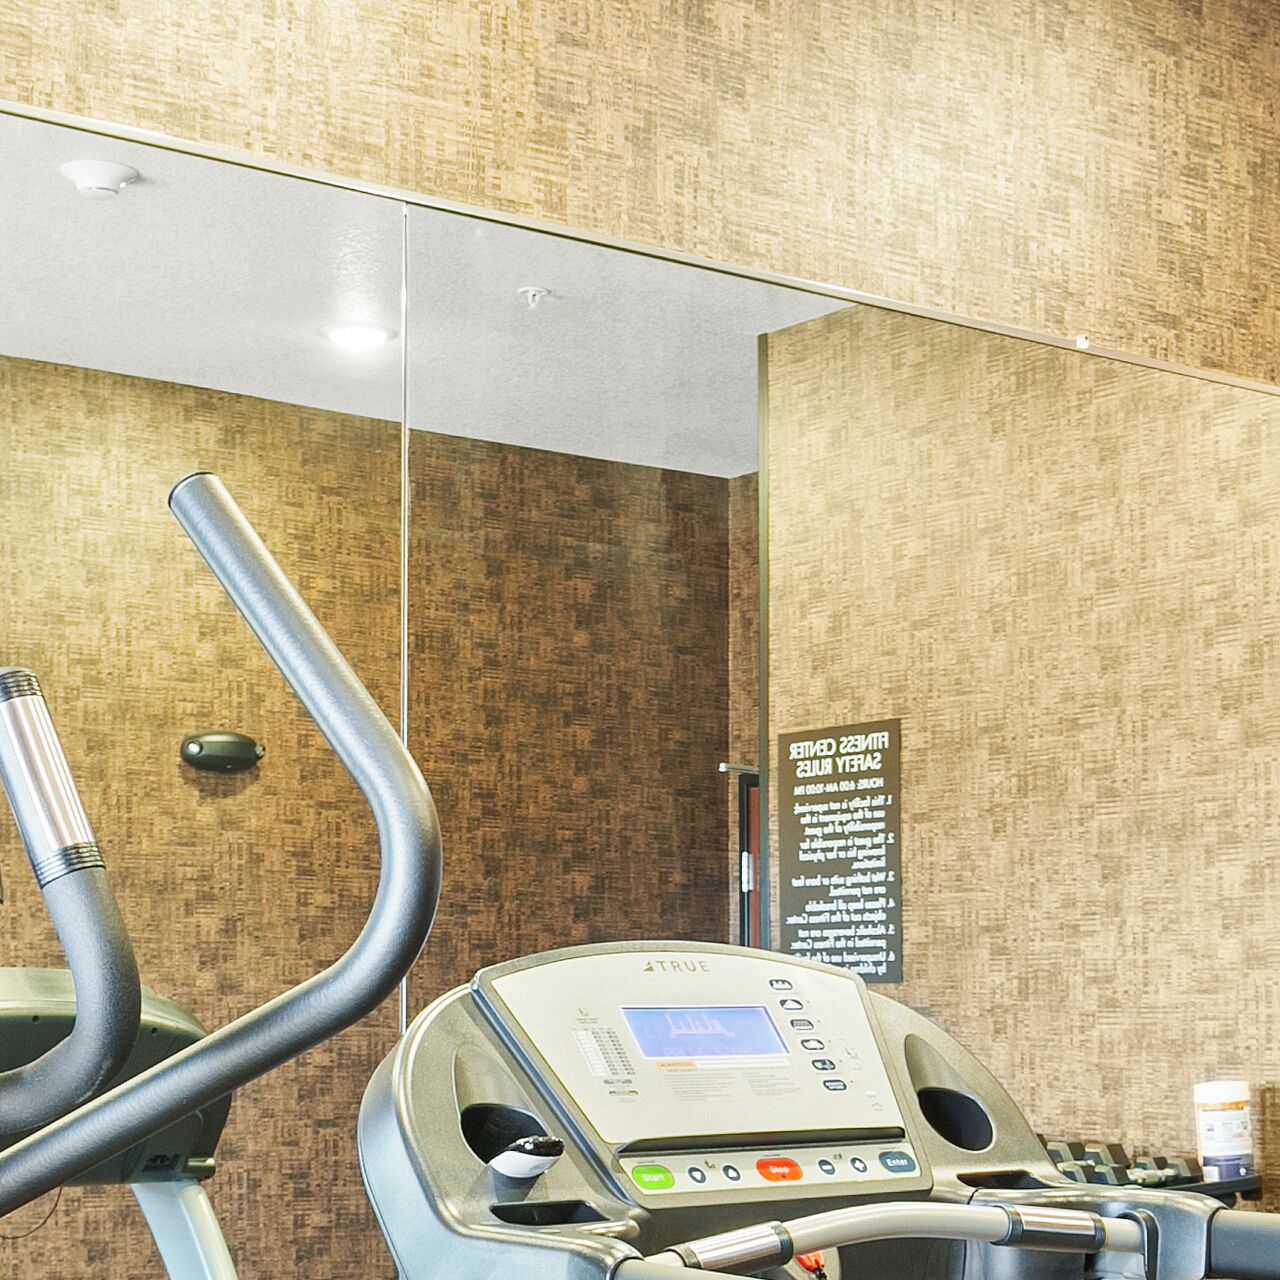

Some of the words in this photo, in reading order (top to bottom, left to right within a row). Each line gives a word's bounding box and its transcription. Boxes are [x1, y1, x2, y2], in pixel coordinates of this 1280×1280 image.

[658, 960, 710, 973] TRUE
[886, 1159, 908, 1167] Enter
[769, 1166, 790, 1174] Stop
